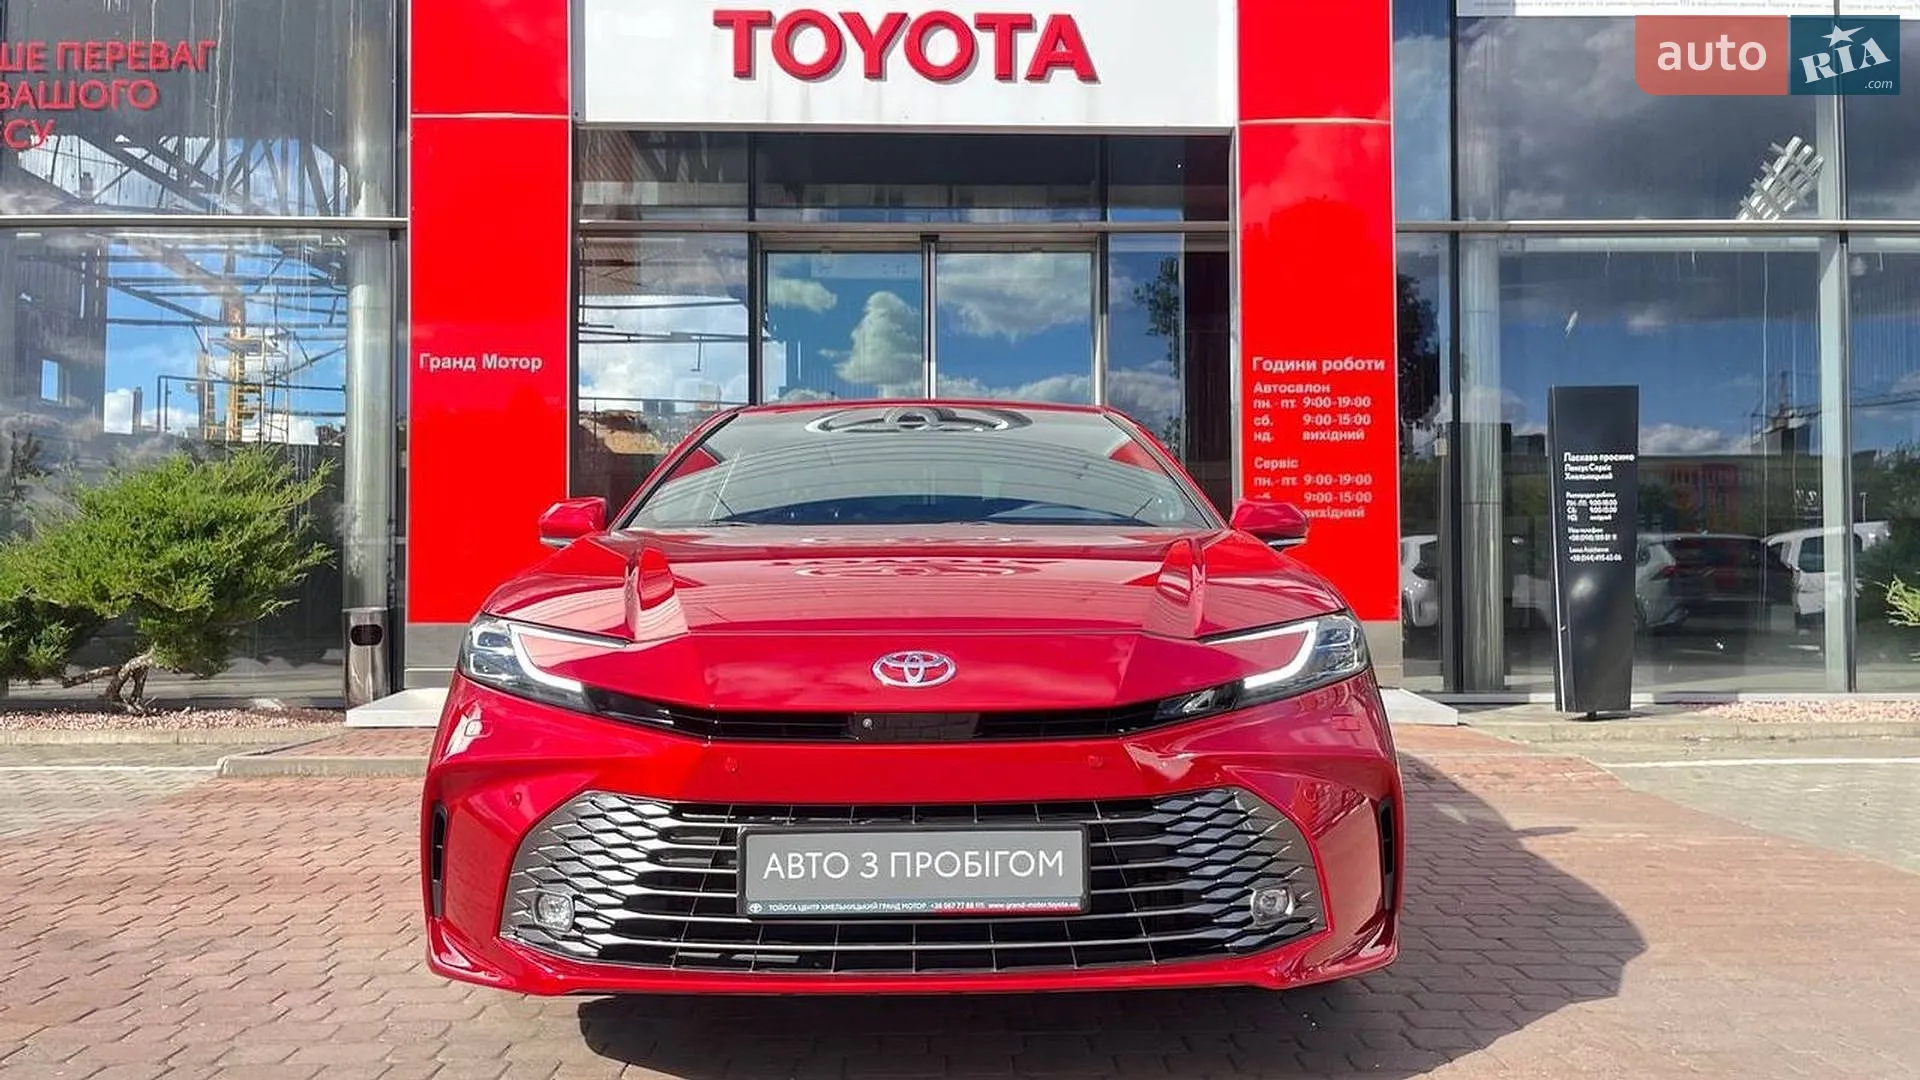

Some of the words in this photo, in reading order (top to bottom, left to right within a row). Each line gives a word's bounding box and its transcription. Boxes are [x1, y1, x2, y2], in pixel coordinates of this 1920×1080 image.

[713, 8, 1100, 83] TOYOTA
[57, 40, 217, 73] ПЕРЕВАГ
[419, 352, 477, 372] Гранд
[482, 353, 543, 373] Мотор
[1252, 356, 1317, 373] Години
[1322, 356, 1385, 375] роботи
[1253, 382, 1331, 394] Автосалон
[1302, 429, 1365, 442] вихідний
[1254, 456, 1299, 471] Сервіс
[763, 852, 850, 879] АВТО
[890, 850, 1064, 878] ПРОБІГОМ
